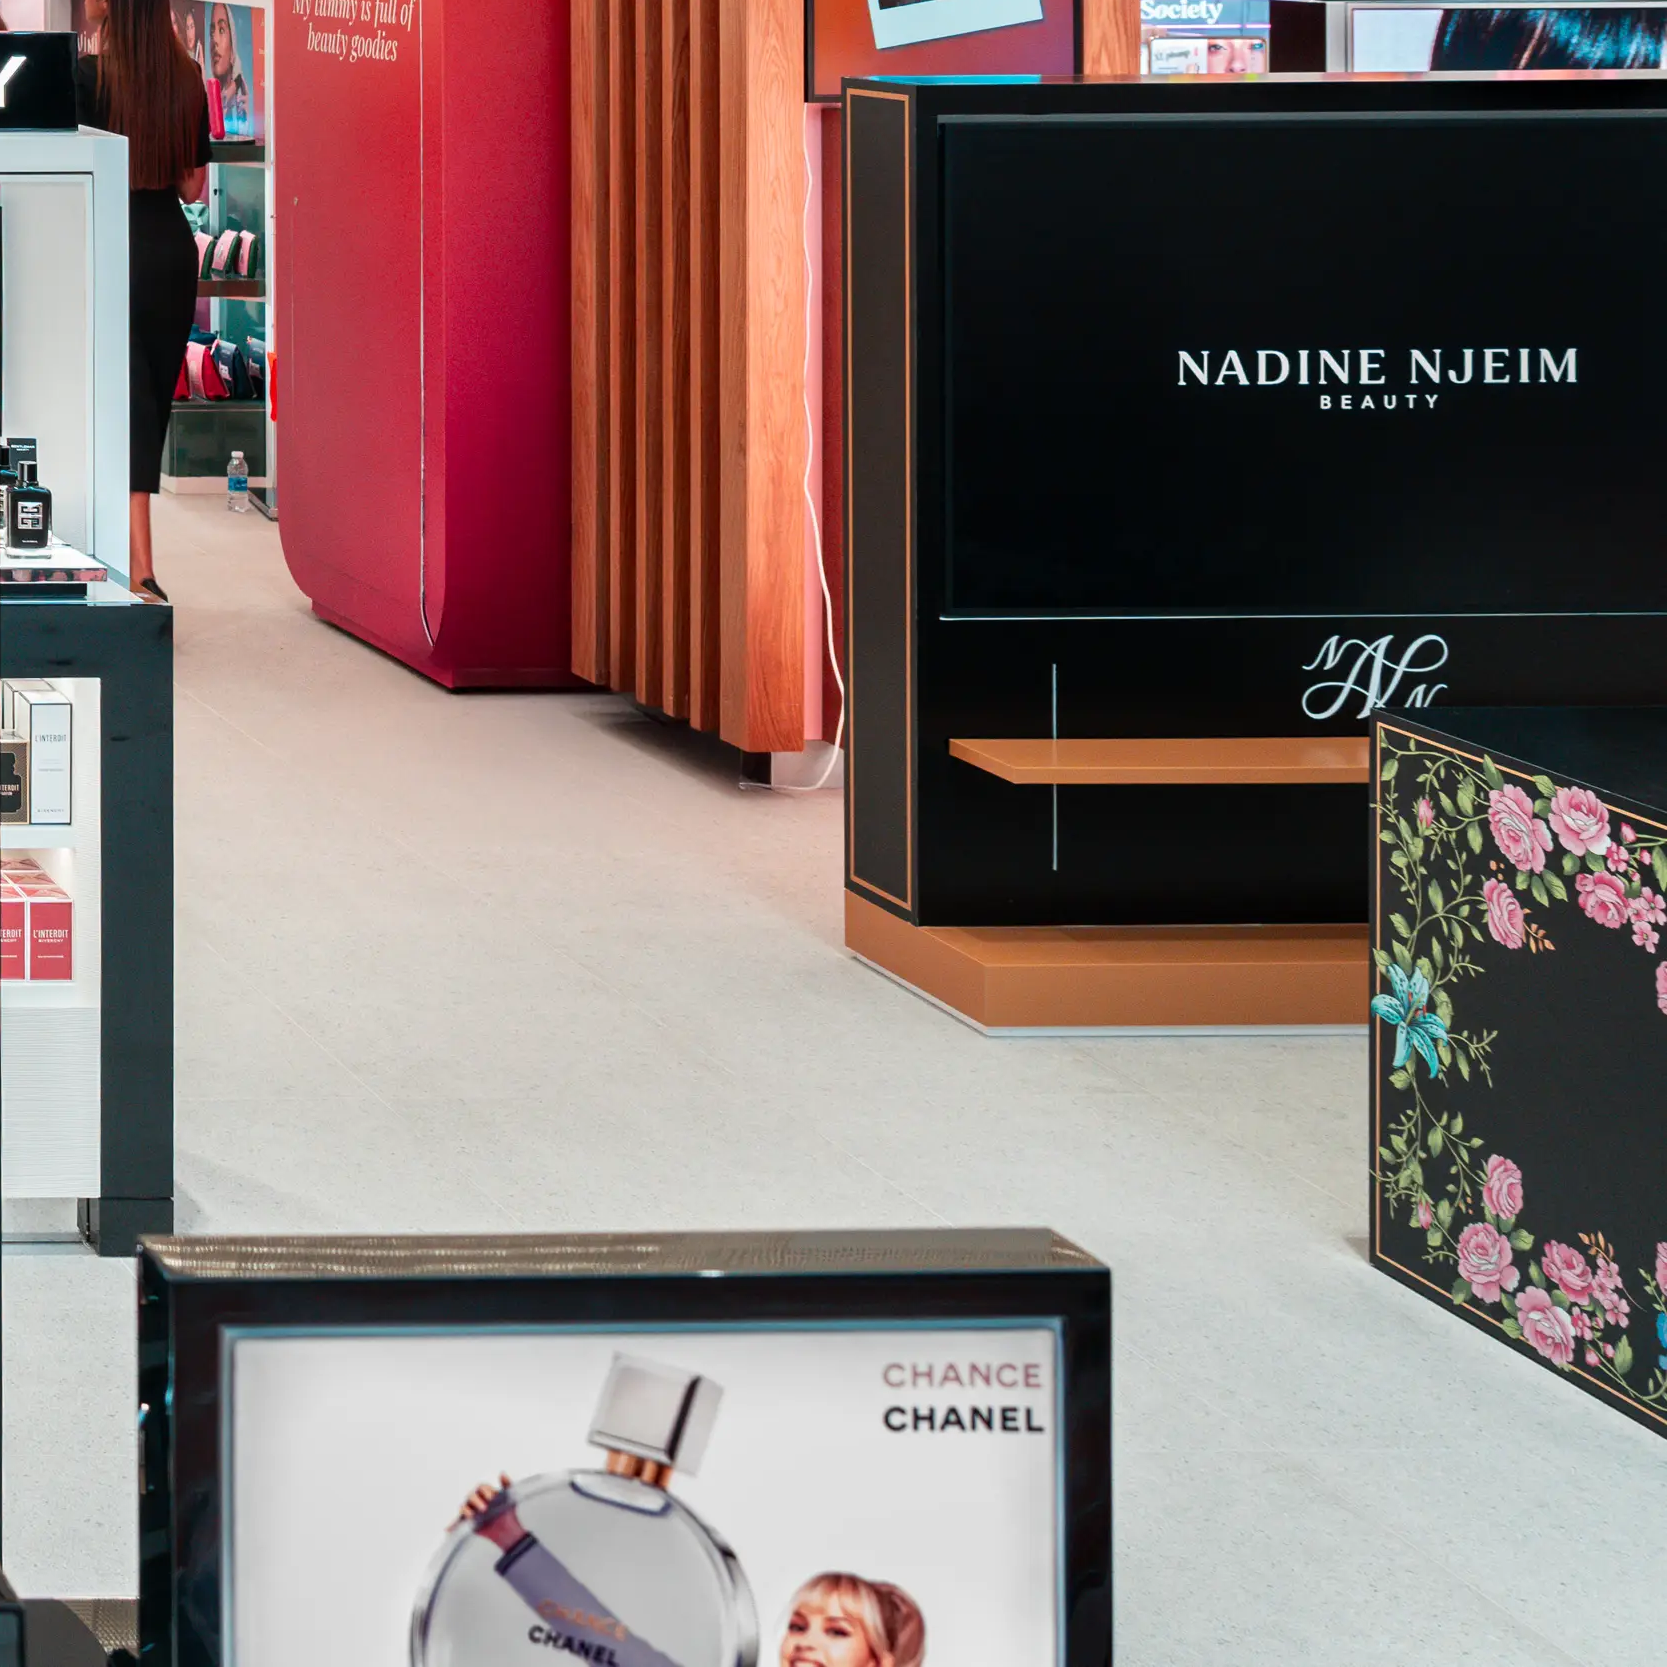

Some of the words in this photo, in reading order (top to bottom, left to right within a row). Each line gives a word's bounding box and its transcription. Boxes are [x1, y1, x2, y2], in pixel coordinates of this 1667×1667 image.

[1141, 0, 1223, 24] Society
[307, 22, 348, 60] beauty
[349, 30, 398, 63] goodies
[1177, 348, 1386, 387] NADINE
[1409, 348, 1579, 386] NJEIM
[1320, 394, 1441, 410] BEAUTY
[34, 734, 67, 743] L'INTERDIT
[33, 929, 68, 938] L'INTERDIT
[882, 1361, 1044, 1390] CHANCE
[882, 1405, 1045, 1435] CHANEL
[538, 1599, 628, 1642] CHANCE
[528, 1624, 619, 1667] CHANEL
